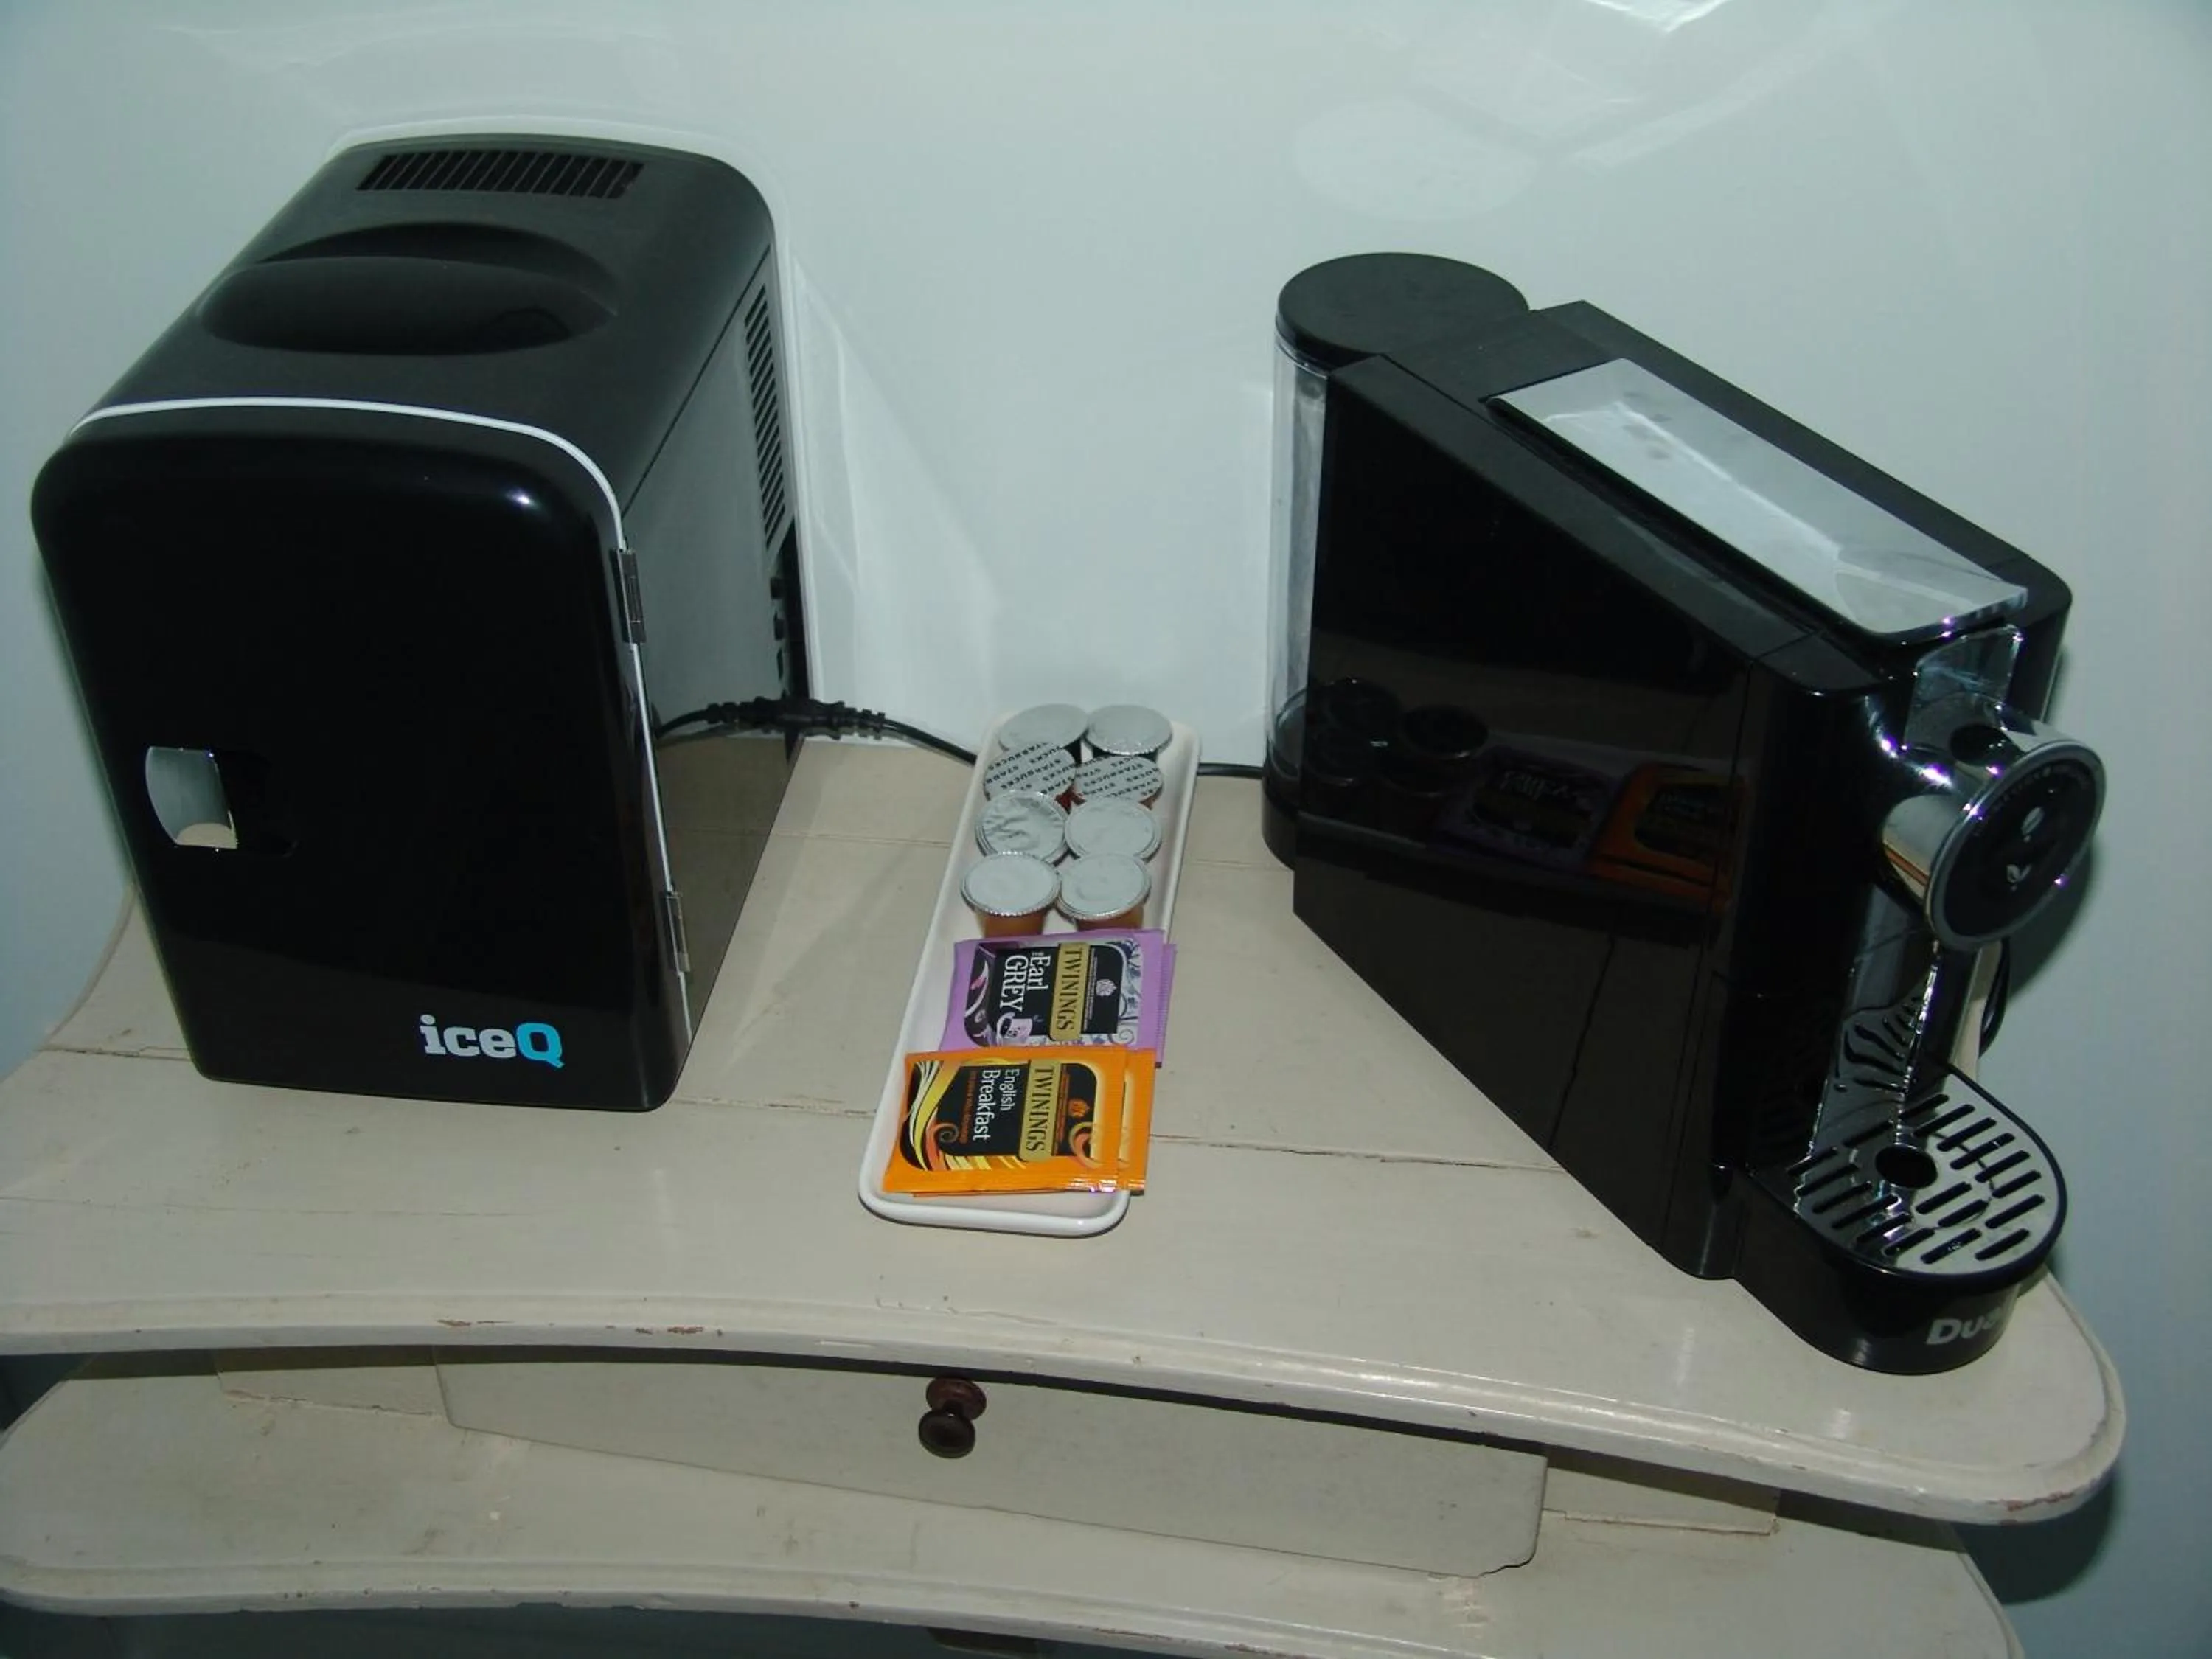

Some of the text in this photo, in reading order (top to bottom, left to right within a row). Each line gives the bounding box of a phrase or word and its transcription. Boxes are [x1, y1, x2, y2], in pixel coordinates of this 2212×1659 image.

[1000, 955, 1029, 1012] GREY
[1026, 956, 1051, 990] Earl
[1056, 948, 1082, 1030] TWININGS
[420, 1014, 565, 1068] iceQ
[973, 1069, 1001, 1141] Breakfast
[1000, 1068, 1020, 1111] English
[1026, 1067, 1054, 1152] TWININGS
